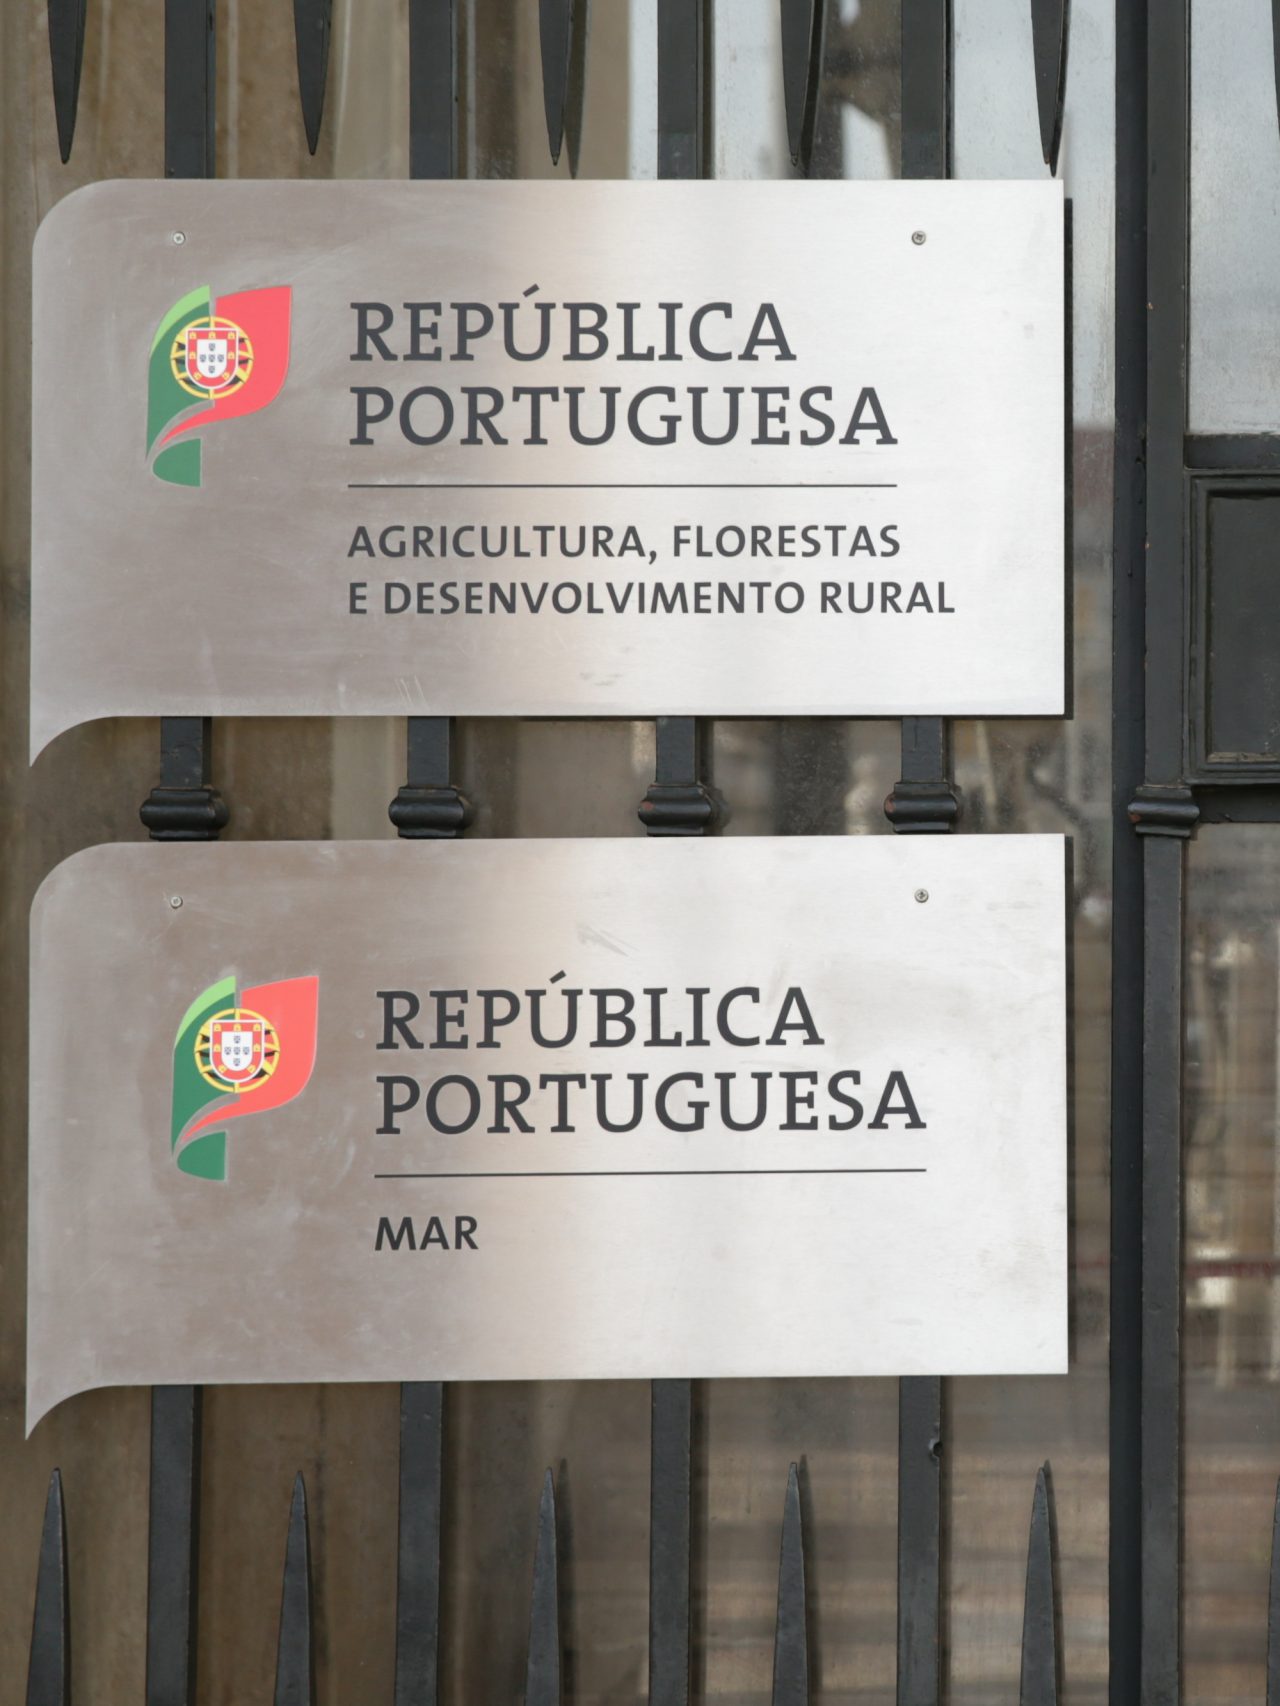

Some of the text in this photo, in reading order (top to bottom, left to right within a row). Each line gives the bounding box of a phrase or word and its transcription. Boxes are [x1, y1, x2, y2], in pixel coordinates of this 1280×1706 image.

[350, 284, 797, 362] REPÚBLICA
[350, 386, 898, 447] PORTUGUESA
[348, 525, 900, 565] AGRICULTURA, FLORESTAS
[350, 581, 955, 614] E DESENVOLVIMENTO RURAL
[376, 970, 825, 1050] REPÚBLICA
[376, 1070, 927, 1135] PORTUGUESA
[375, 1216, 478, 1251] MAR
